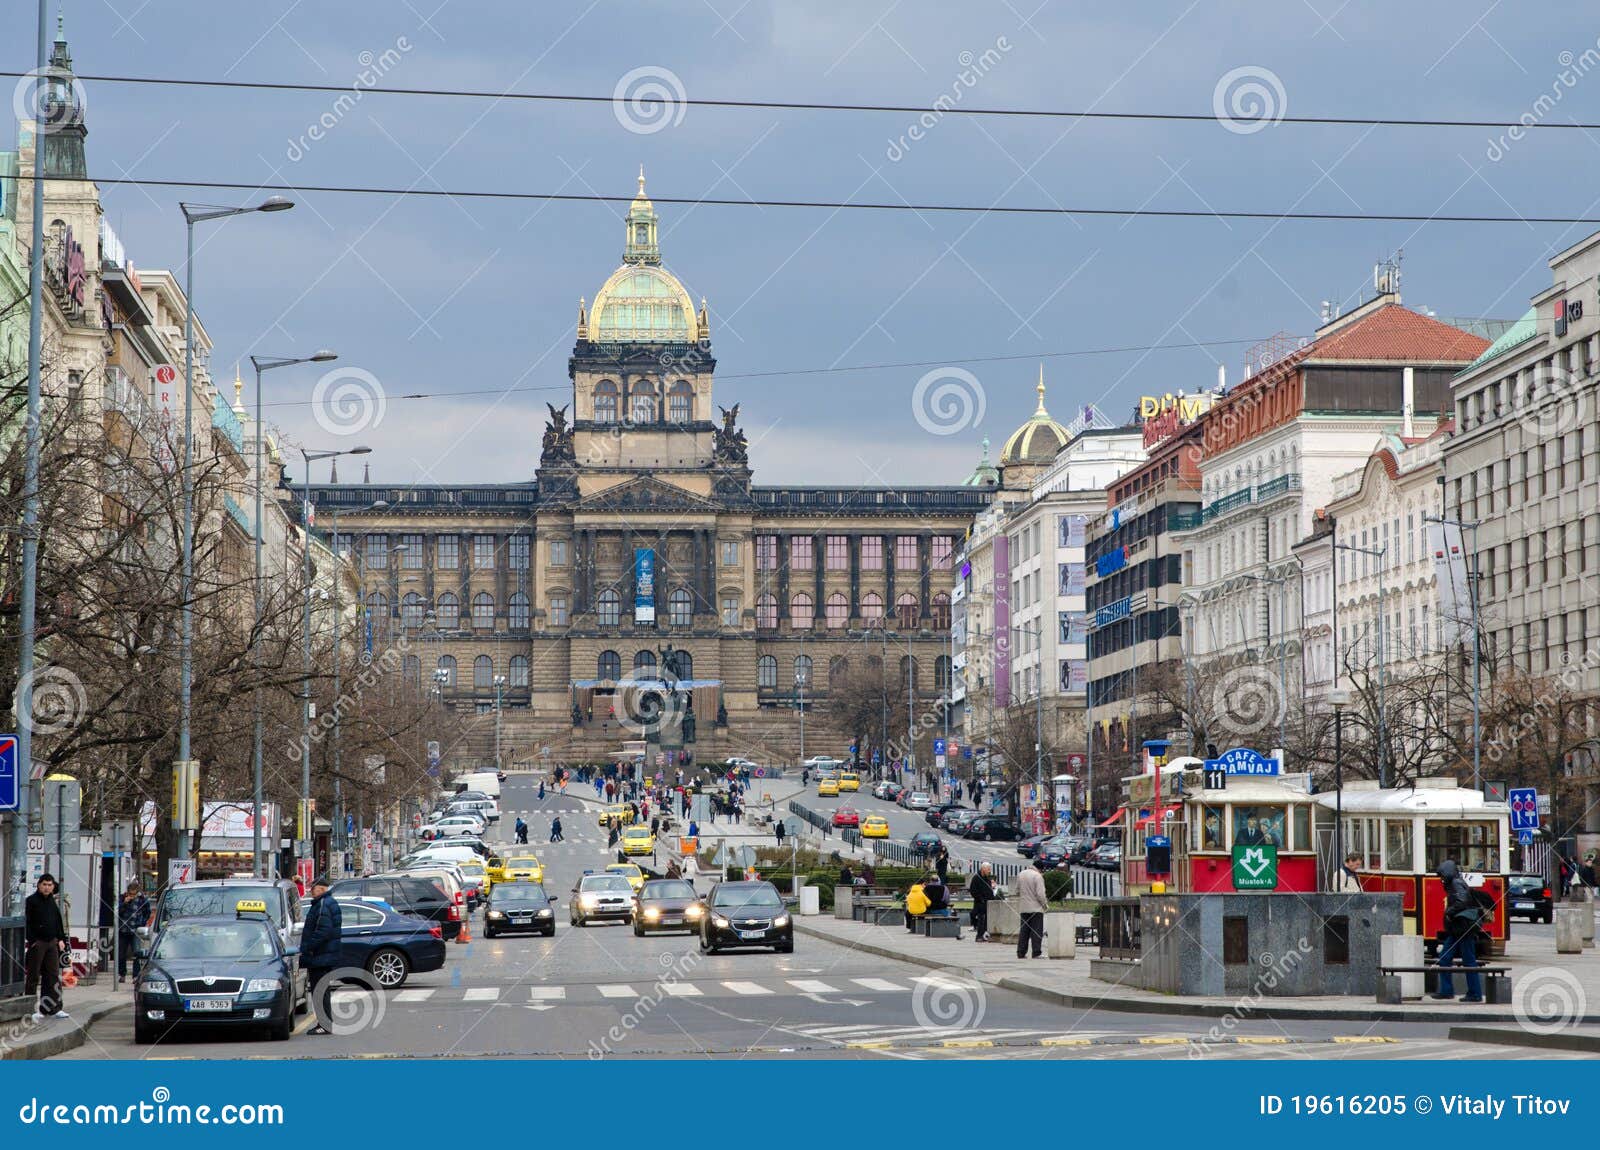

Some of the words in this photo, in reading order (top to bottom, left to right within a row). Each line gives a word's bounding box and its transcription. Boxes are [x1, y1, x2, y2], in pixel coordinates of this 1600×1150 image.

[1568, 300, 1583, 323] KB
[1226, 751, 1256, 763] CAFE
[1212, 761, 1272, 774] TRAMVAJ
[1209, 771, 1222, 789] 11
